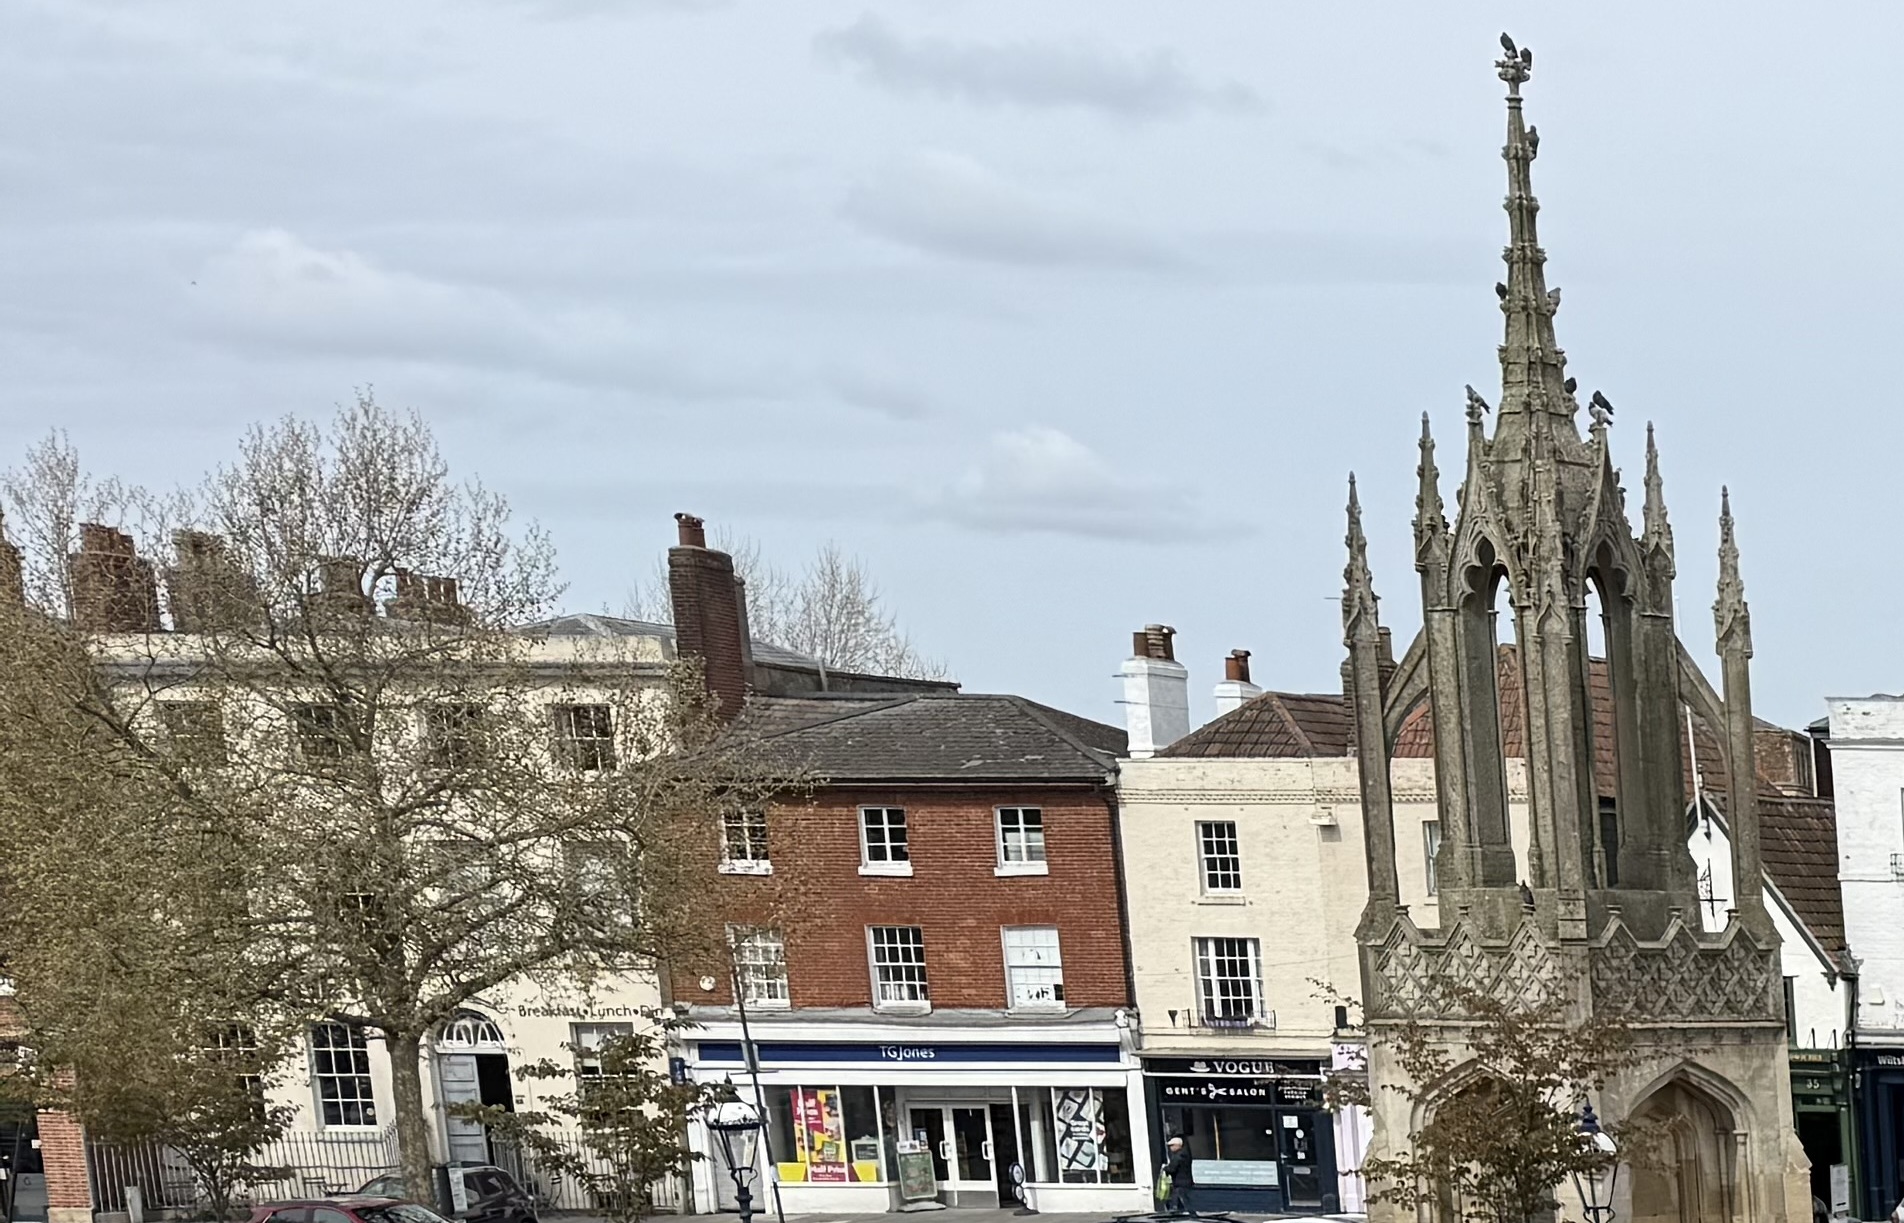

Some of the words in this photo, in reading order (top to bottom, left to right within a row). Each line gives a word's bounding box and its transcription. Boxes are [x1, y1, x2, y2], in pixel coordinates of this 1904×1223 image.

[1213, 1061, 1274, 1074] VOGUE
[1165, 1087, 1207, 1096] GENT'S
[1229, 1087, 1266, 1096] SALON
